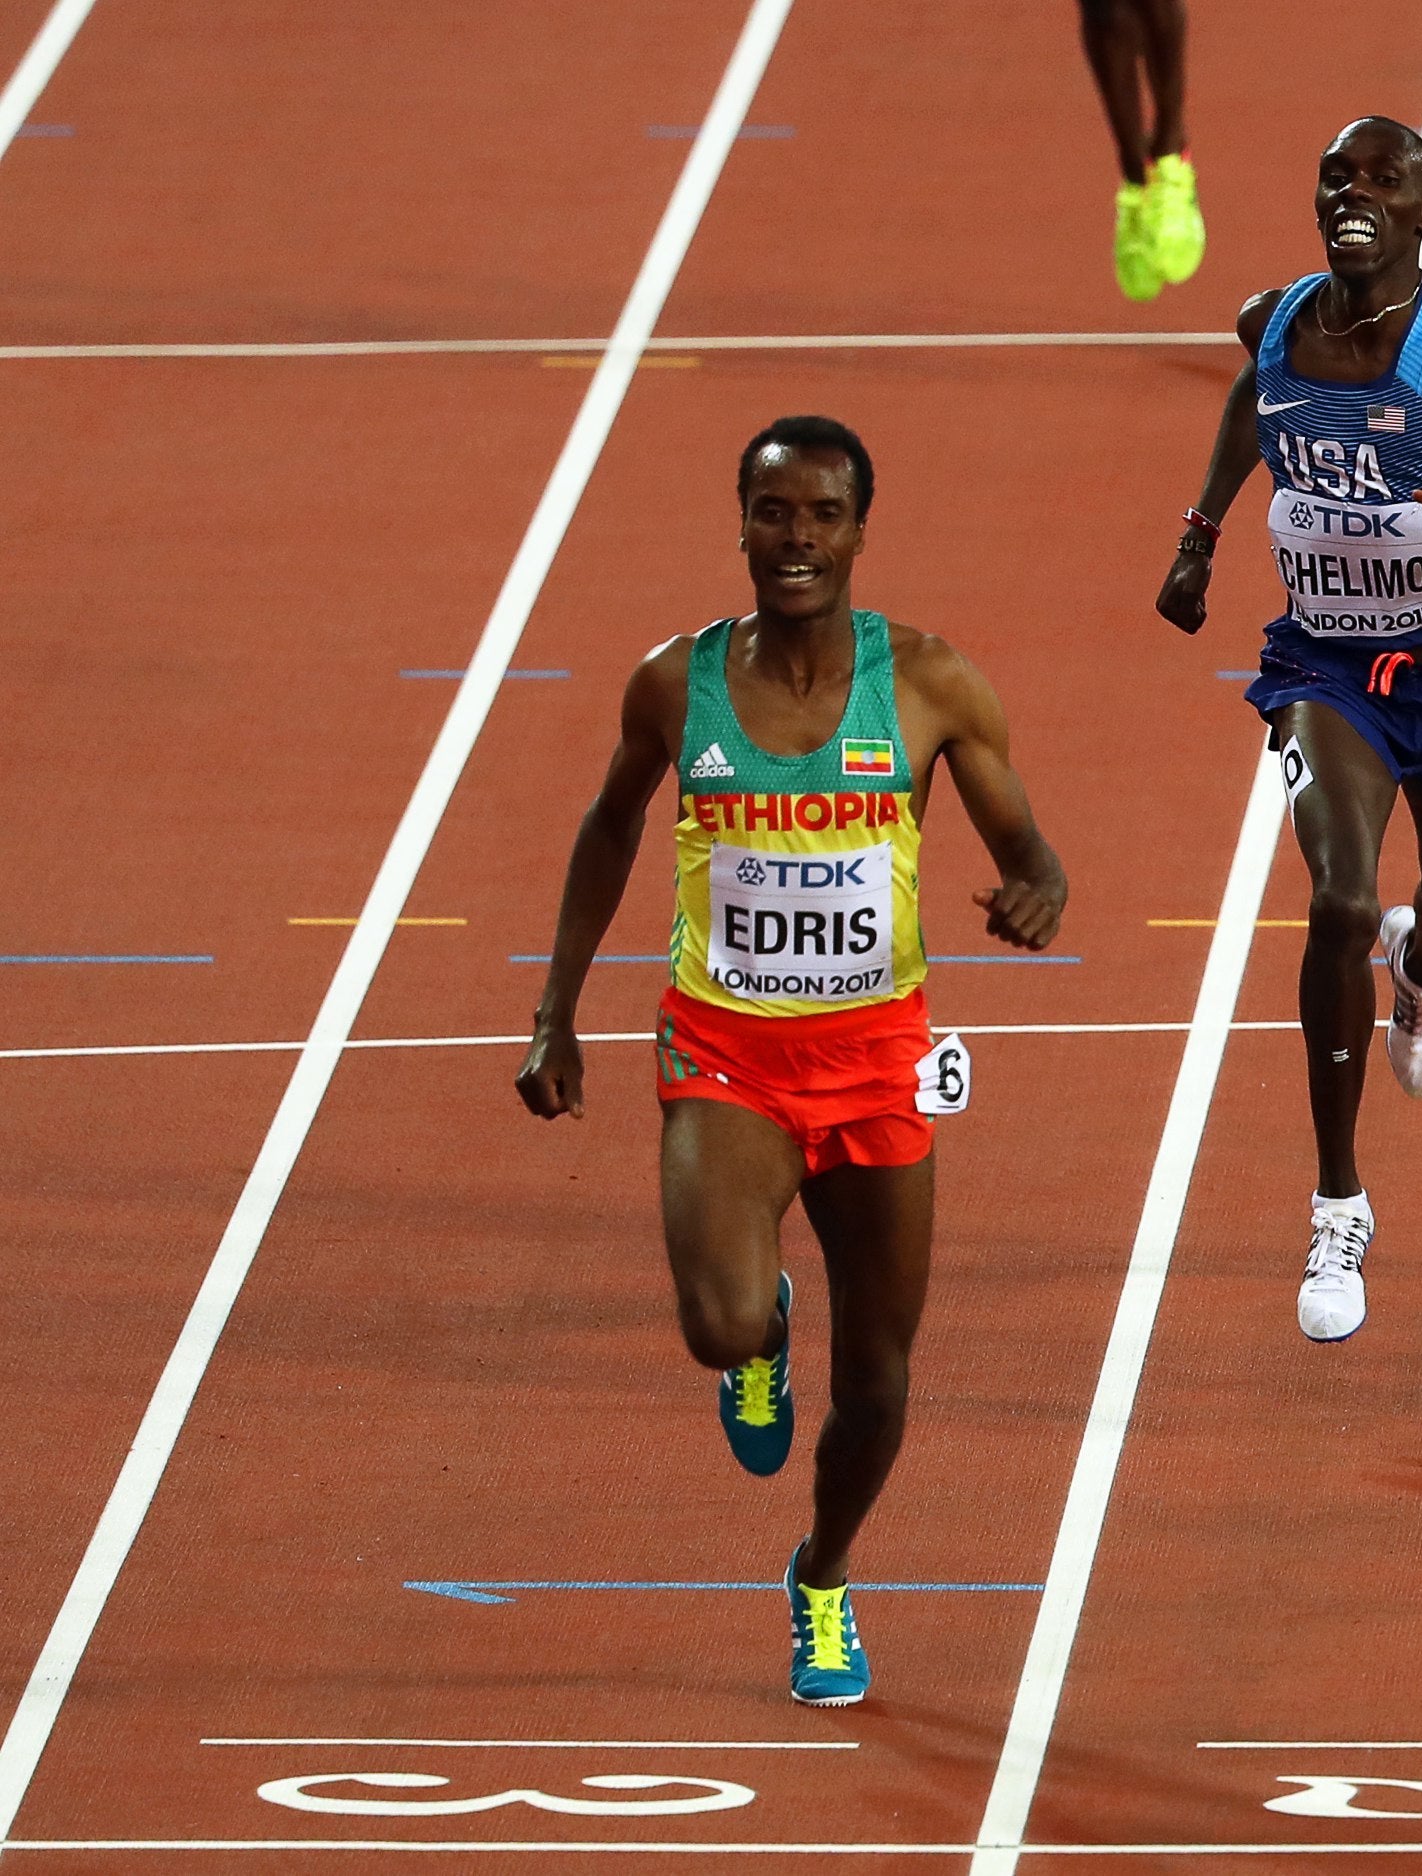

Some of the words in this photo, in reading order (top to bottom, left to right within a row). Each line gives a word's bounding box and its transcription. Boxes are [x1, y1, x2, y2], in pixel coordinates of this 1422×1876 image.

[1278, 432, 1392, 500] USA
[1314, 507, 1405, 538] TDK
[1296, 614, 1377, 632] NDON
[694, 792, 900, 832] ETHIOPIA
[766, 858, 865, 888] TDK
[724, 904, 877, 955] EDRIS
[829, 967, 885, 995] 2017
[937, 1048, 964, 1102] 6
